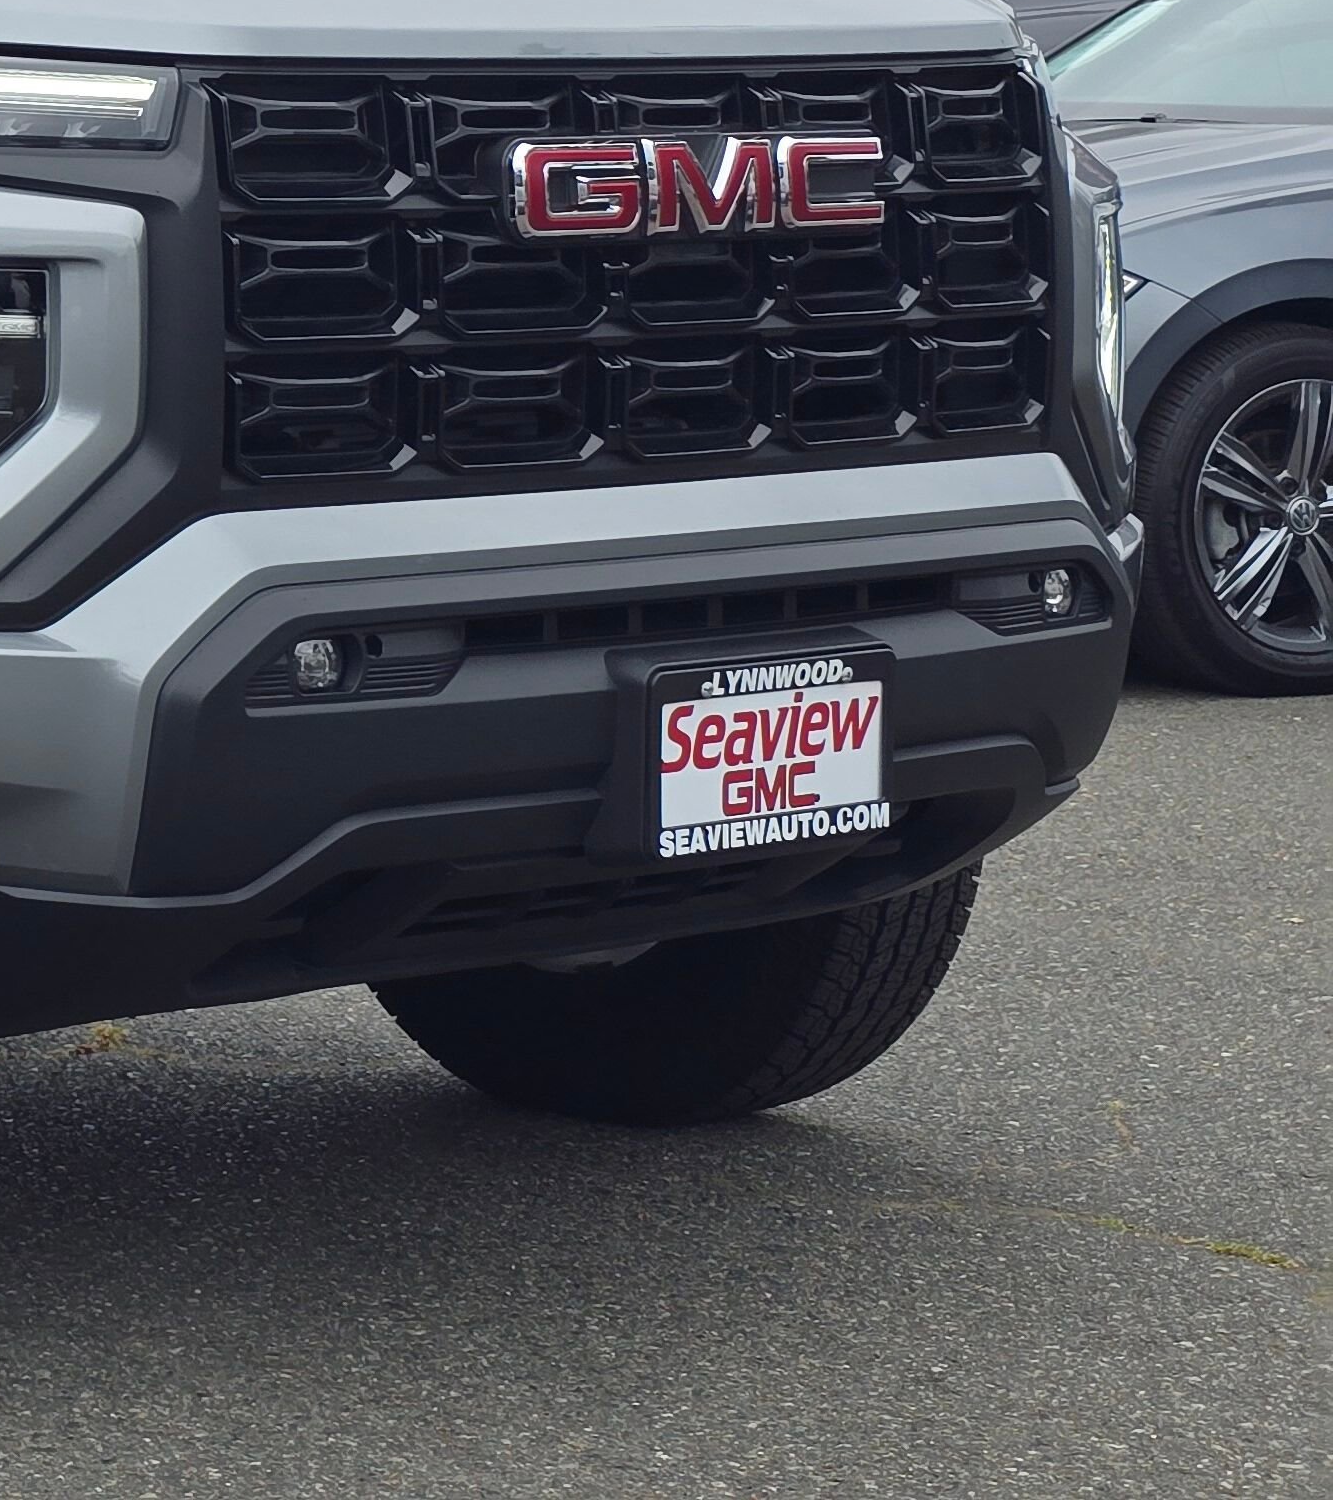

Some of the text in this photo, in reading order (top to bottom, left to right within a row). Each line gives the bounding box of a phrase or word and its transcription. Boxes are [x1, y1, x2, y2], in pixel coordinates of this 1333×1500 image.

[512, 135, 886, 238] GMC
[711, 658, 844, 696] LYNNWOOD
[660, 691, 879, 773] Seaview
[722, 760, 817, 817] GMC
[659, 802, 891, 859] SEAVIEWAUTO.COM
